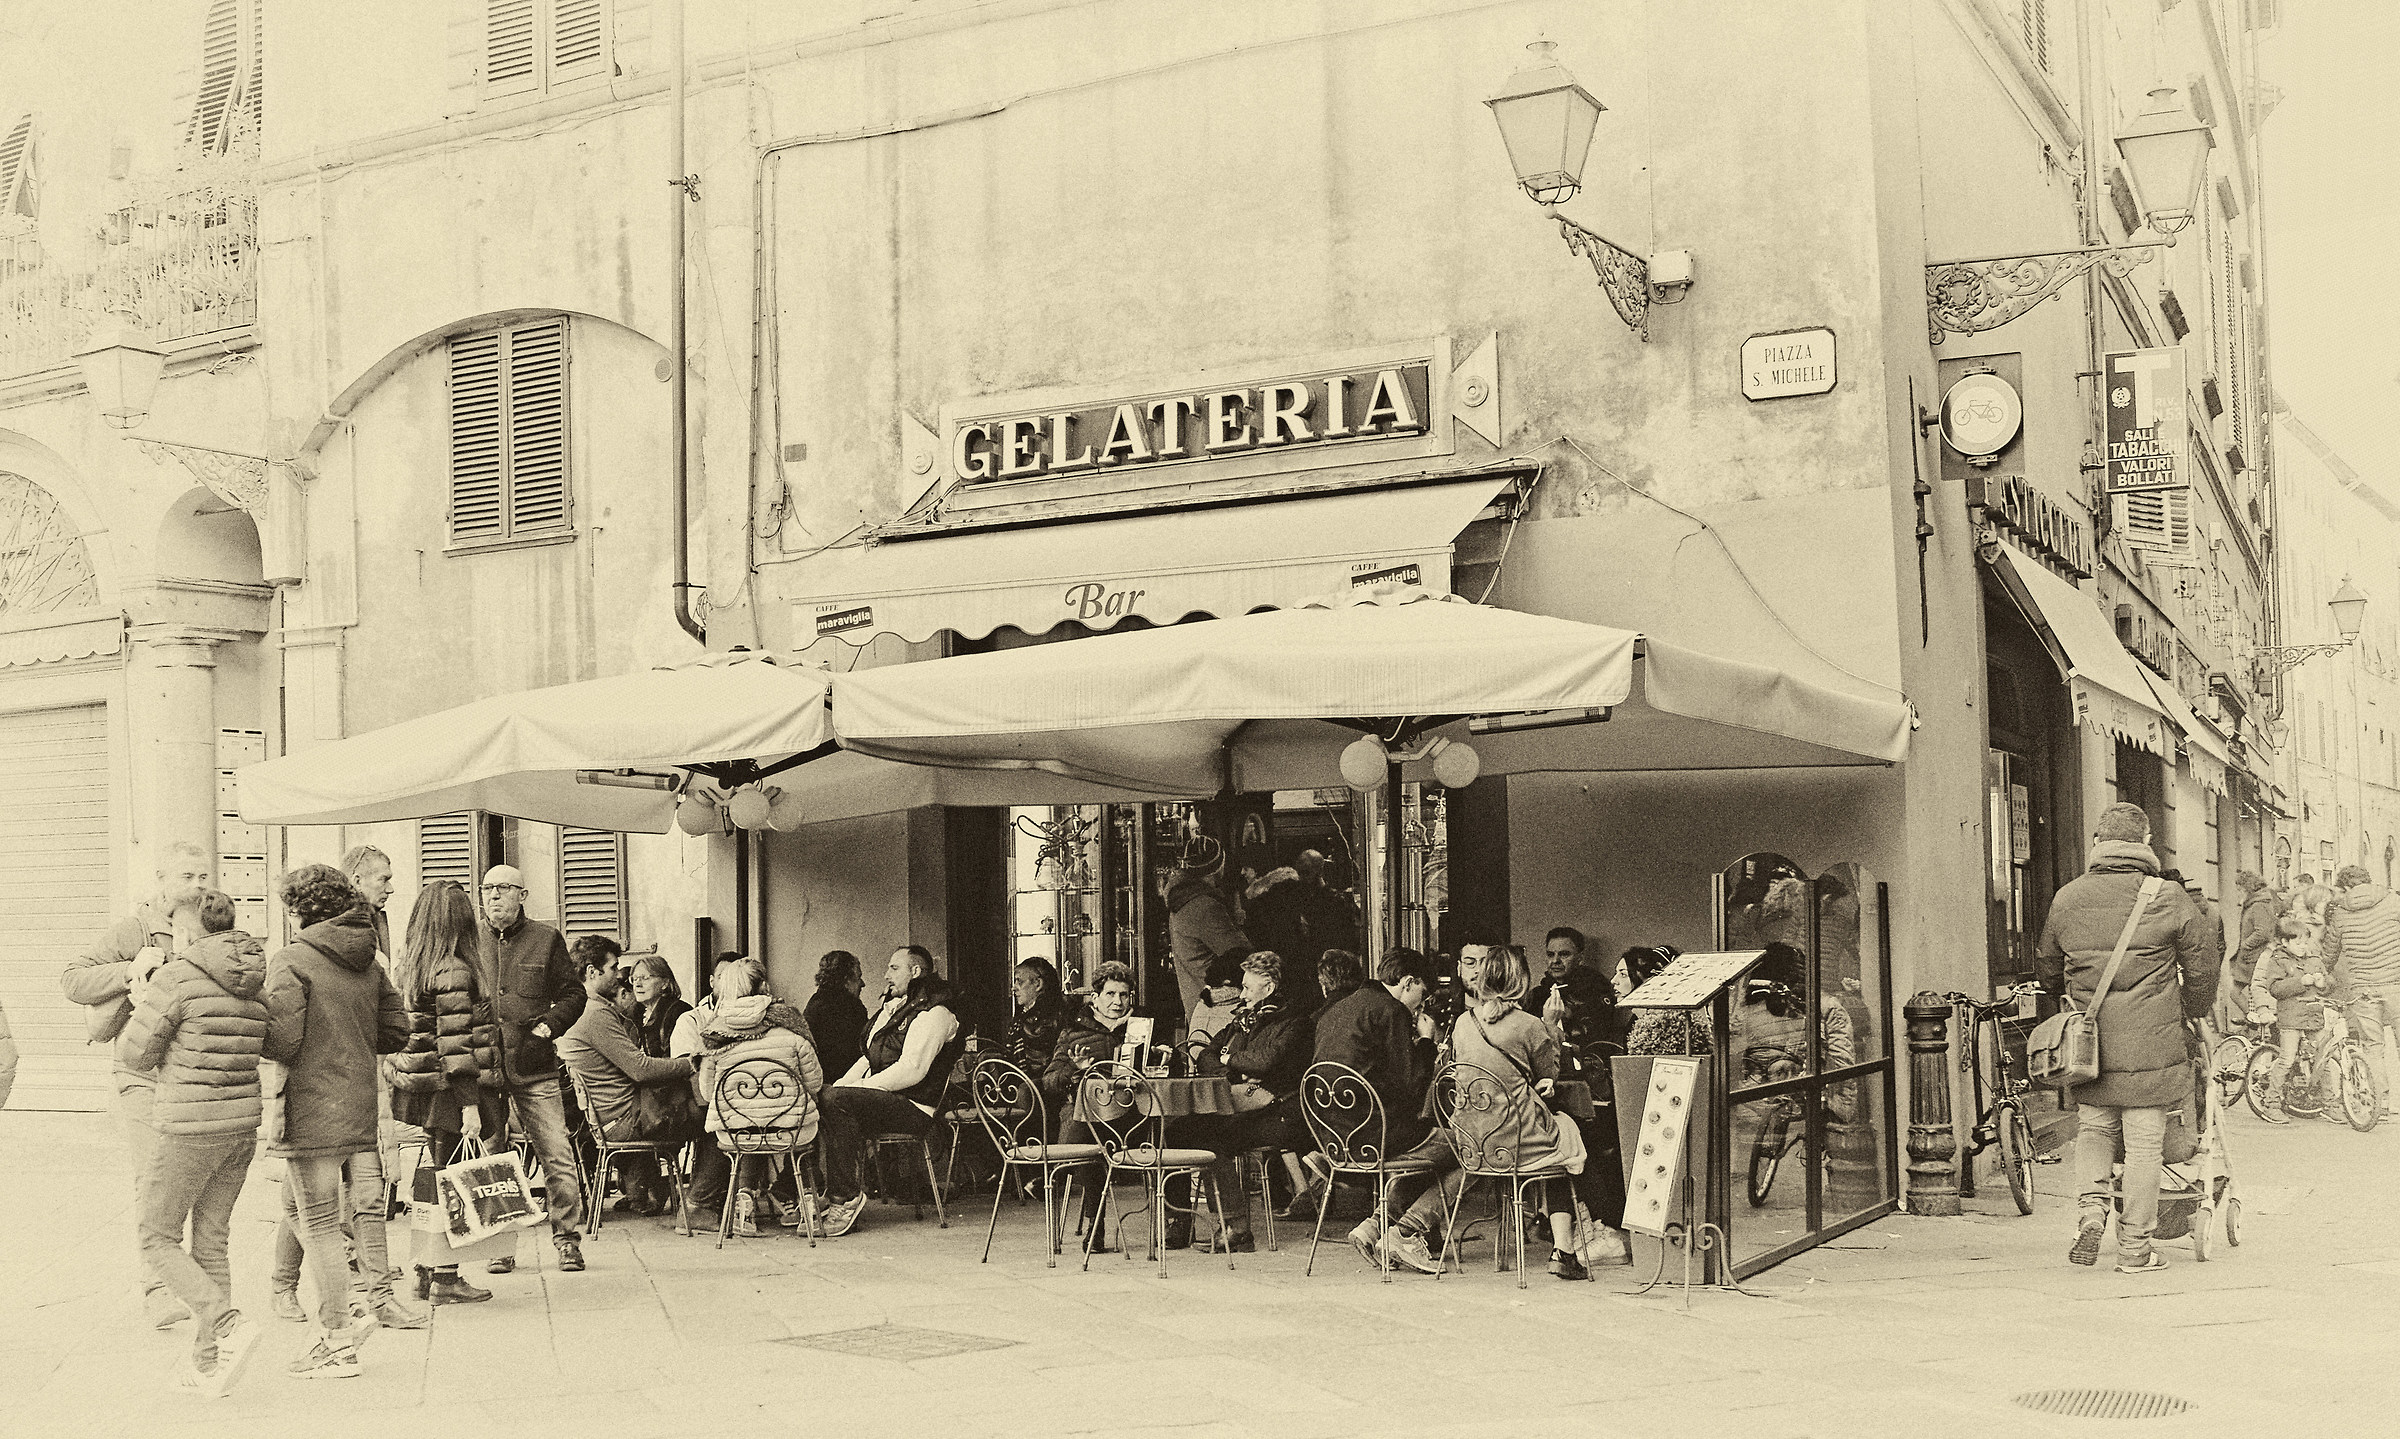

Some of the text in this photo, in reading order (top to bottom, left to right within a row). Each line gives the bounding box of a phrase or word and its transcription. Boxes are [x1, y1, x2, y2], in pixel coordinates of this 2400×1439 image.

[1764, 344, 1812, 363] PIAZZA
[1752, 365, 1826, 387] S. MICHELE
[2114, 353, 2172, 429] T
[953, 368, 1421, 483] GELATERIA
[2124, 427, 2166, 442] SALI E
[2109, 438, 2183, 459] TABACCHI
[2120, 458, 2172, 473] VALORI
[2117, 470, 2177, 487] BOLLATI
[1064, 583, 1146, 620] Bar
[817, 611, 871, 631] maraviglia
